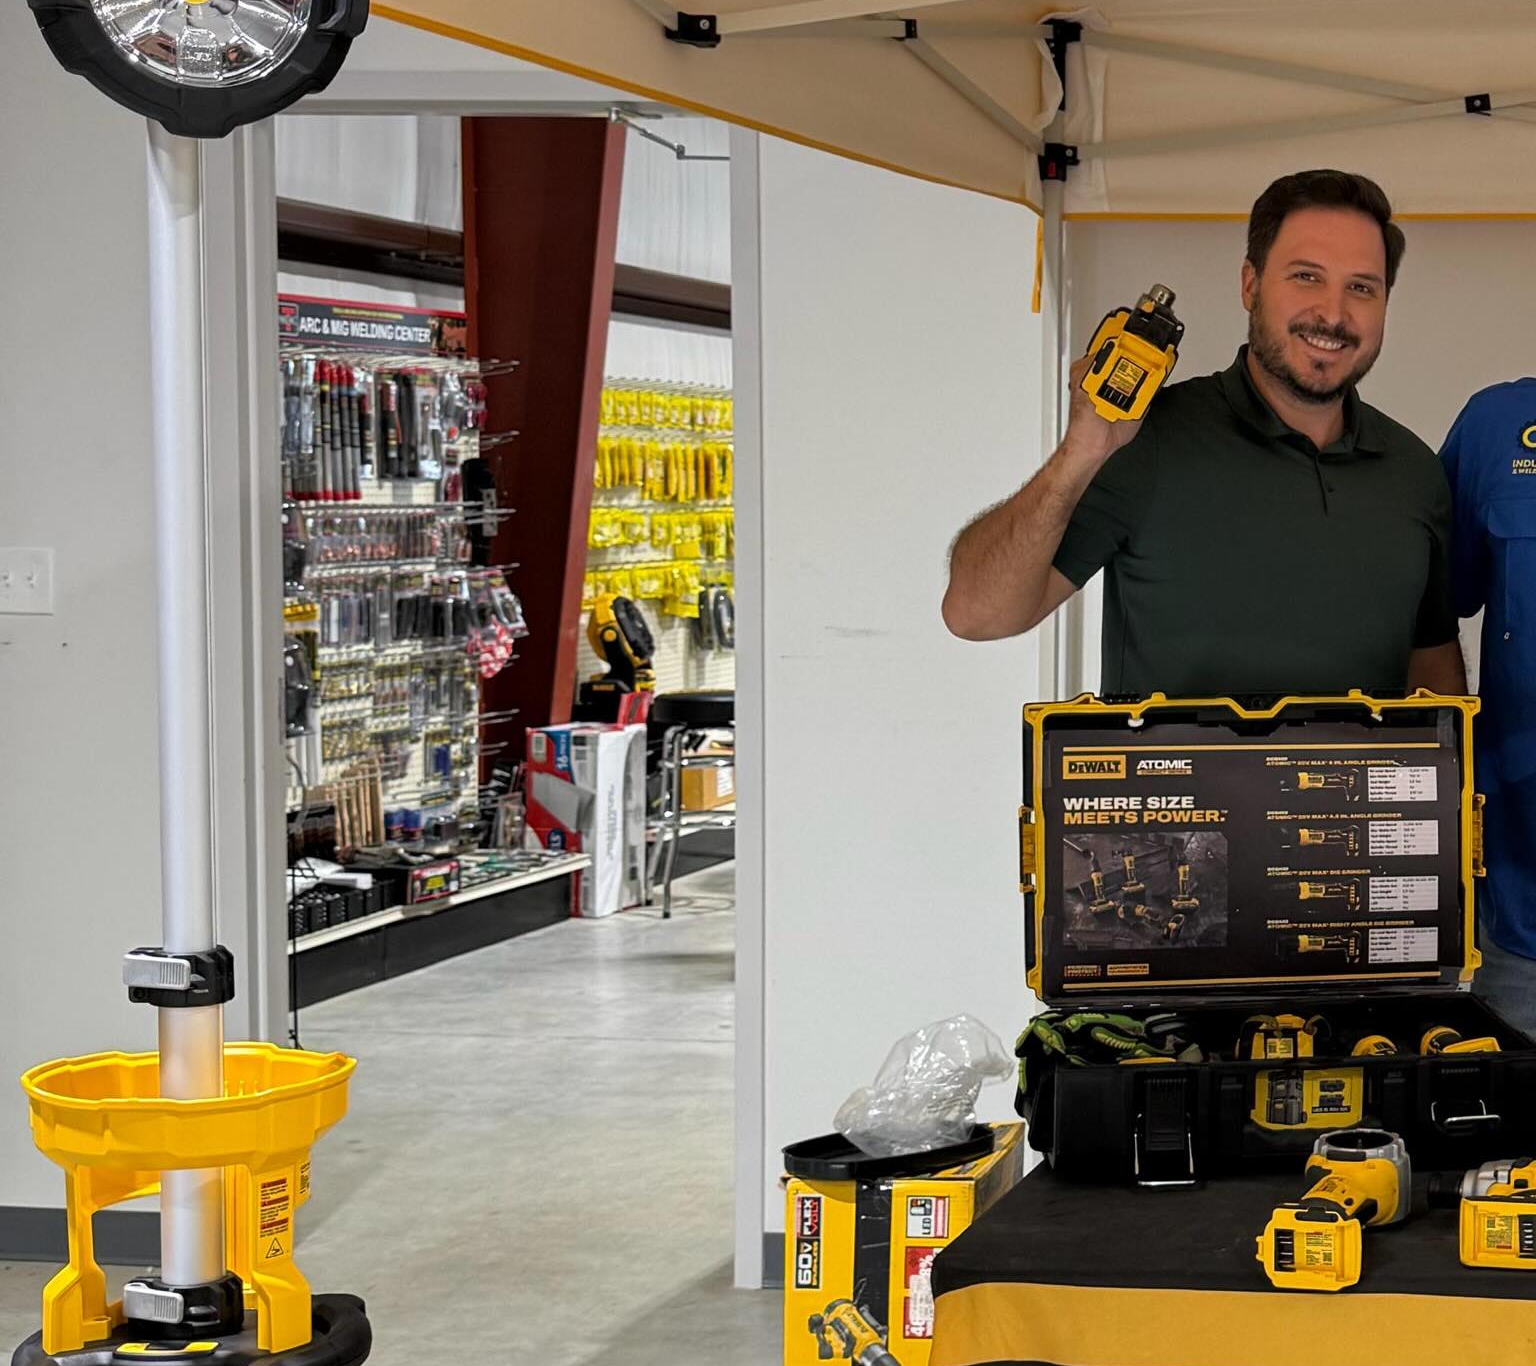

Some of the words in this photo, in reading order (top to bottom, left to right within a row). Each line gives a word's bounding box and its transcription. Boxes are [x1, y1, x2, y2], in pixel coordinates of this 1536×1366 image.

[300, 317, 321, 334] ARC
[322, 318, 329, 335] &
[330, 319, 349, 336] MIG
[350, 322, 394, 340] WELDING
[395, 325, 431, 343] CENTER
[1068, 760, 1121, 774] DEWALT
[1136, 760, 1193, 769] ATOMIC
[1063, 797, 1142, 810] WHERE
[1147, 796, 1195, 809] SIZE
[1063, 811, 1138, 825] MEETS
[803, 1198, 813, 1235] FLEX
[922, 1217, 932, 1235] LED
